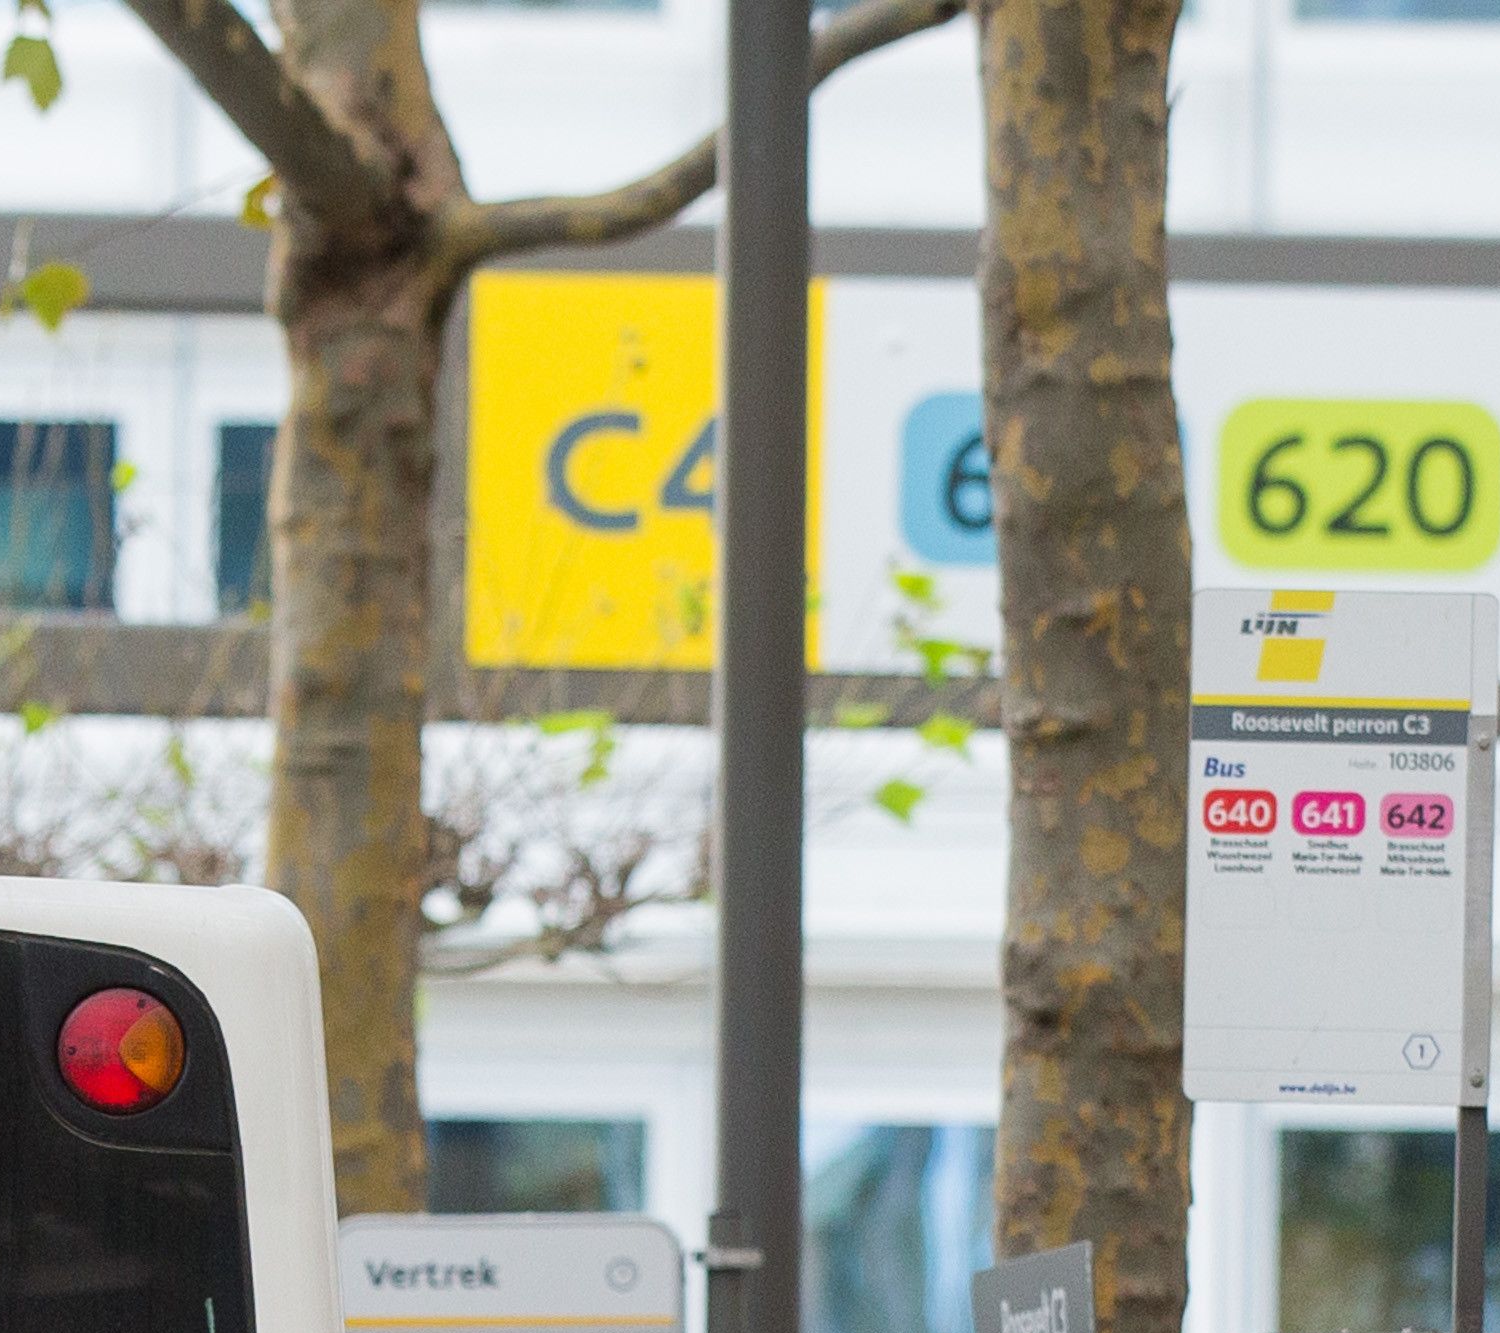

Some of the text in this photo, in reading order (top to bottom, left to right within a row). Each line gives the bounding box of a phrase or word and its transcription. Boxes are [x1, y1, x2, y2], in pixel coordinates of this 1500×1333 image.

[1244, 430, 1477, 540] 620
[1231, 712, 1432, 738] Roosevelt perron C3
[1203, 756, 1247, 778] Bus
[1388, 752, 1456, 771] 103806
[1207, 797, 1272, 828] 640
[1300, 800, 1357, 830] 641
[1386, 803, 1446, 831] 642
[364, 1255, 499, 1291] Vertrek
